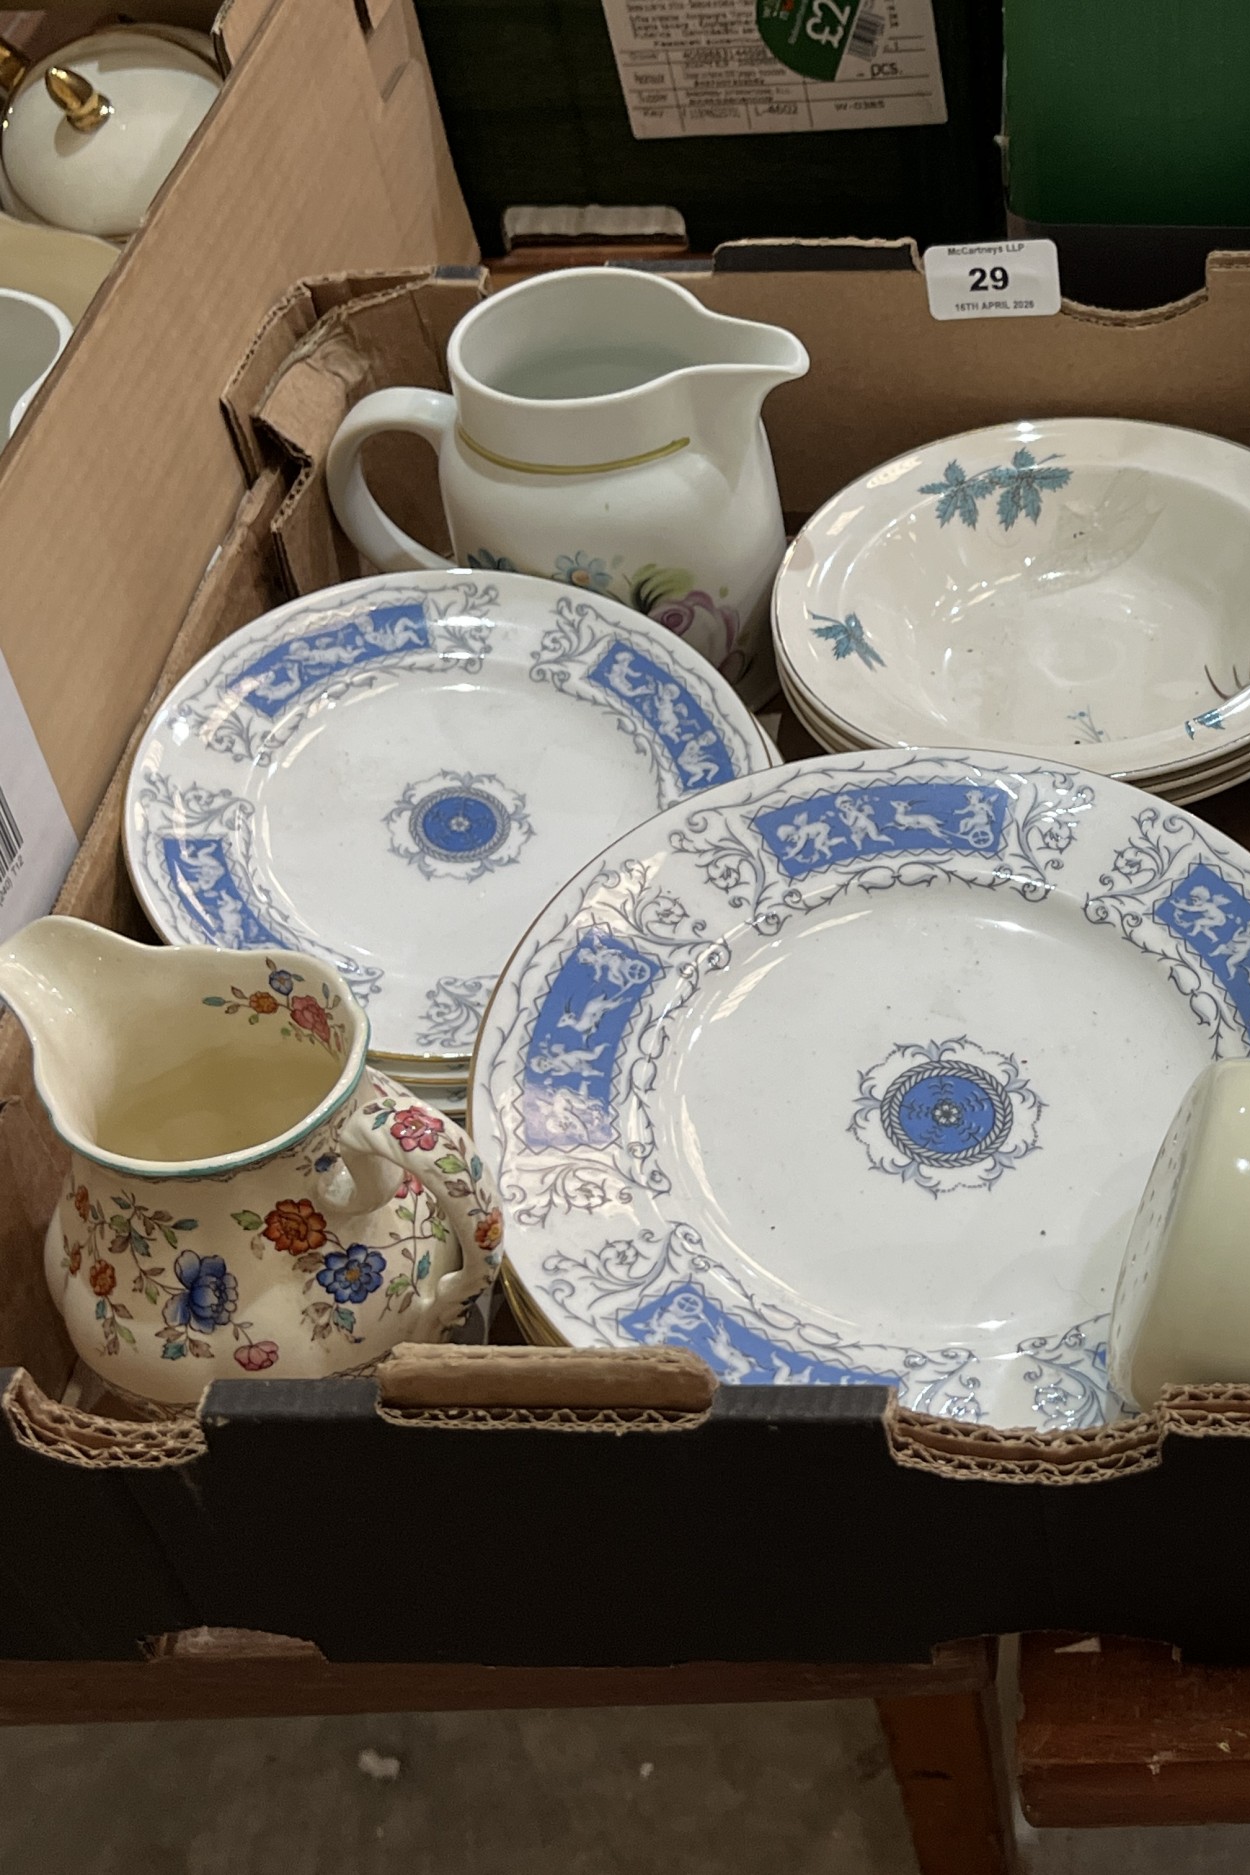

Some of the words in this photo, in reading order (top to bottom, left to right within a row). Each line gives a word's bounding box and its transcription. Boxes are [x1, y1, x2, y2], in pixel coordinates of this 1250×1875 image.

[947, 245, 1003, 256] McCartneys
[1006, 243, 1025, 253] LLP
[968, 266, 1010, 292] 29
[981, 301, 1011, 310] APRIL
